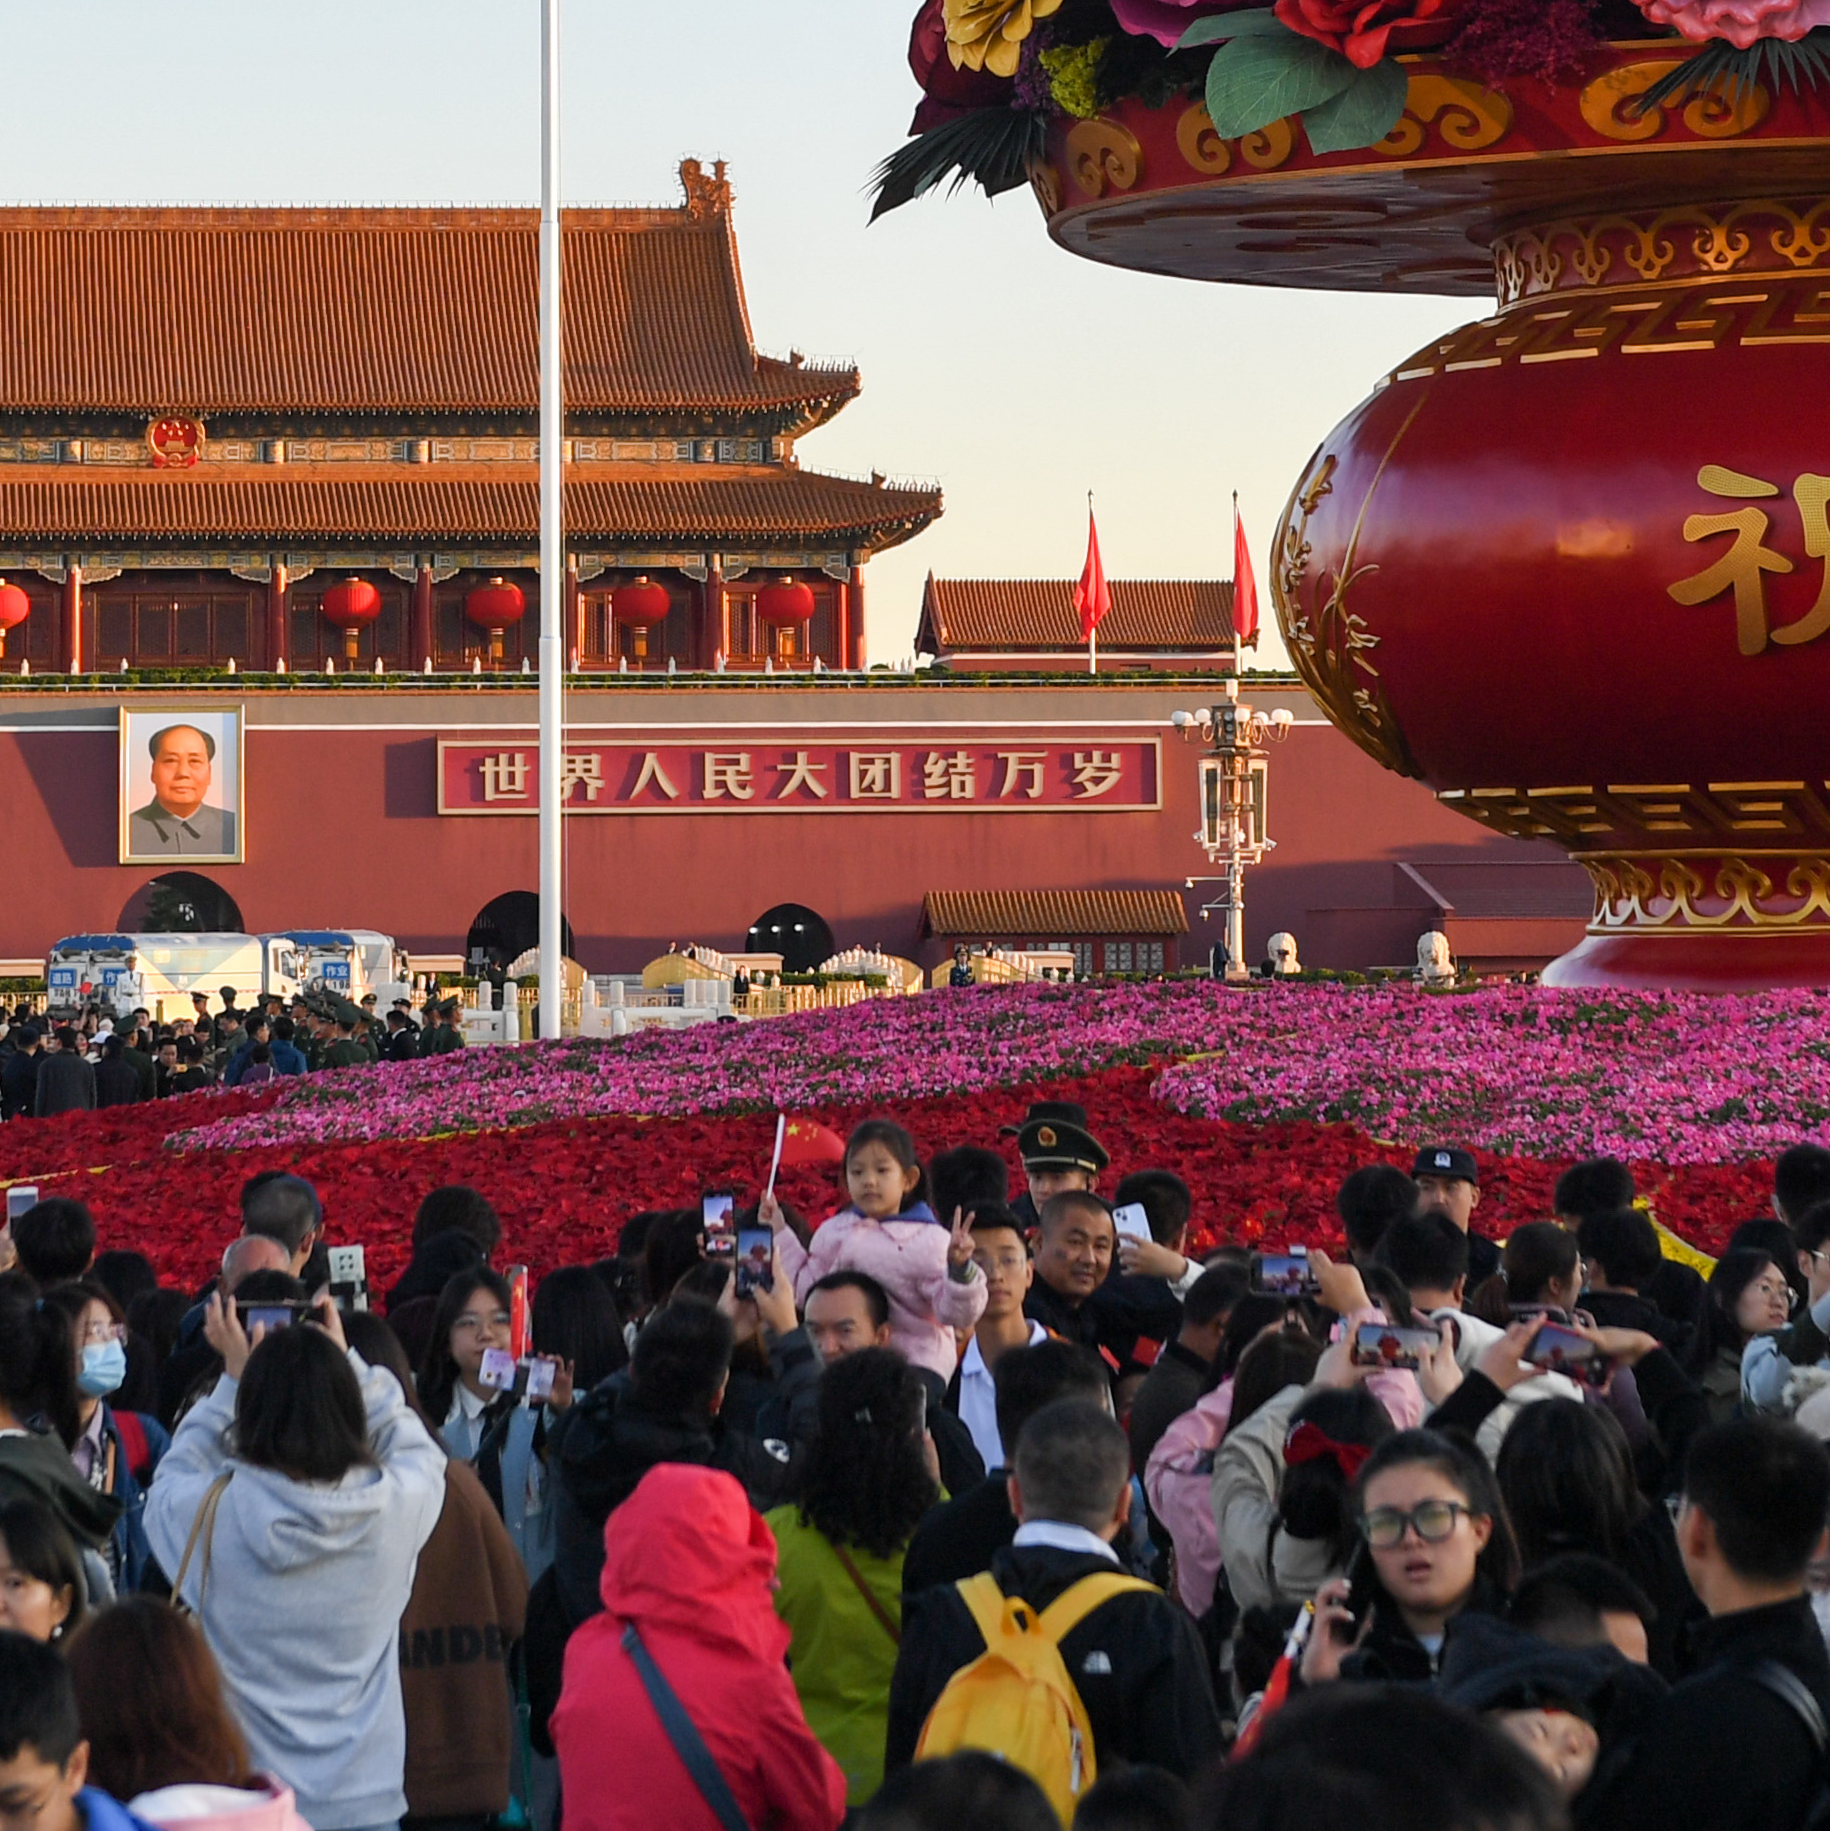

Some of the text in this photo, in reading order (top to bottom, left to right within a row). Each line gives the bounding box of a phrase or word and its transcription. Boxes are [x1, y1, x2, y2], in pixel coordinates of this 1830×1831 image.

[479, 751, 1123, 801] 世界人民大团结万岁
